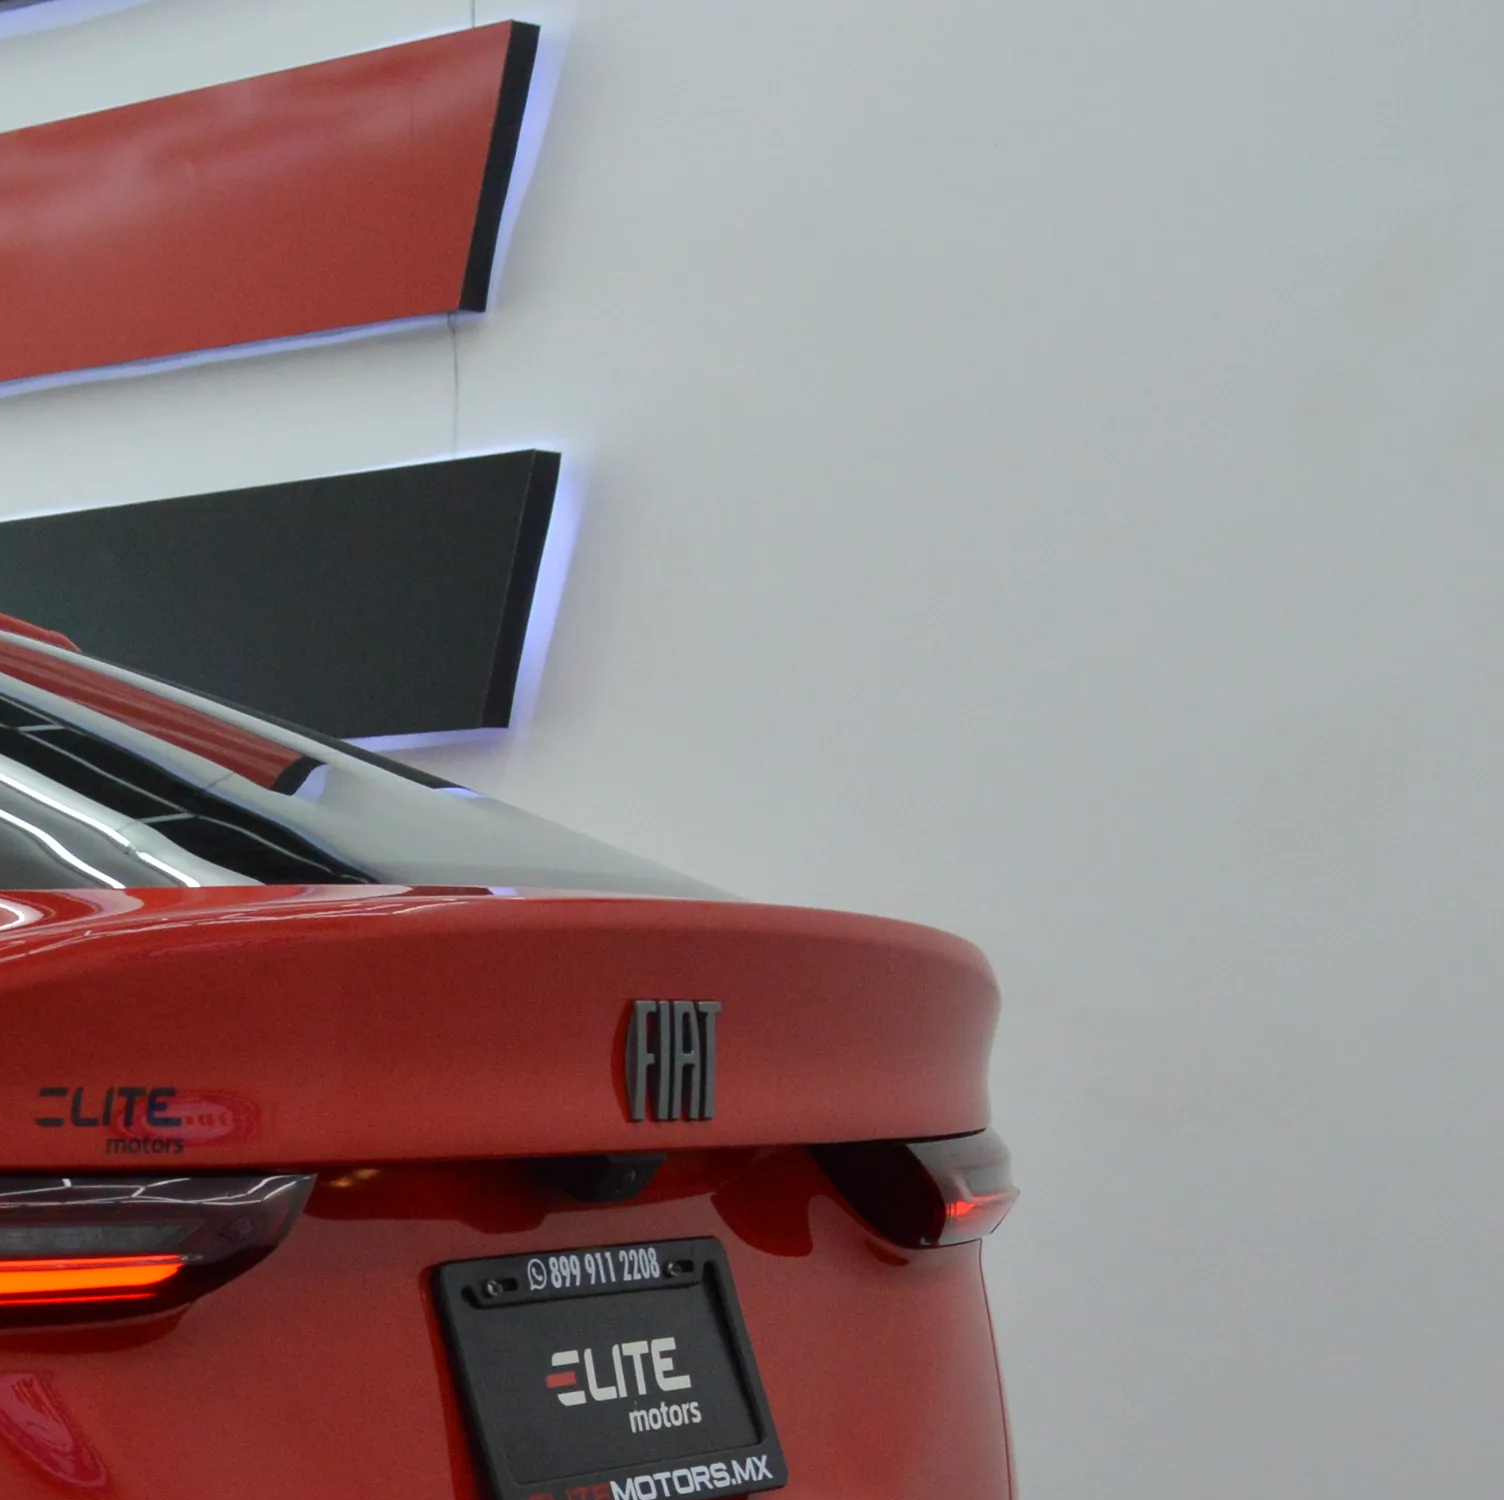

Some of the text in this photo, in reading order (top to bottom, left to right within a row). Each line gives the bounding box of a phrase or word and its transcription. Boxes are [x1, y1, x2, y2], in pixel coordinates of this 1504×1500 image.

[625, 999, 722, 1122] FIAT
[35, 1086, 183, 1127] ELITE
[106, 1138, 184, 1155] motors
[548, 1247, 661, 1288] 899 911 2208
[546, 1337, 692, 1407] ELITE
[629, 1400, 702, 1433] motors
